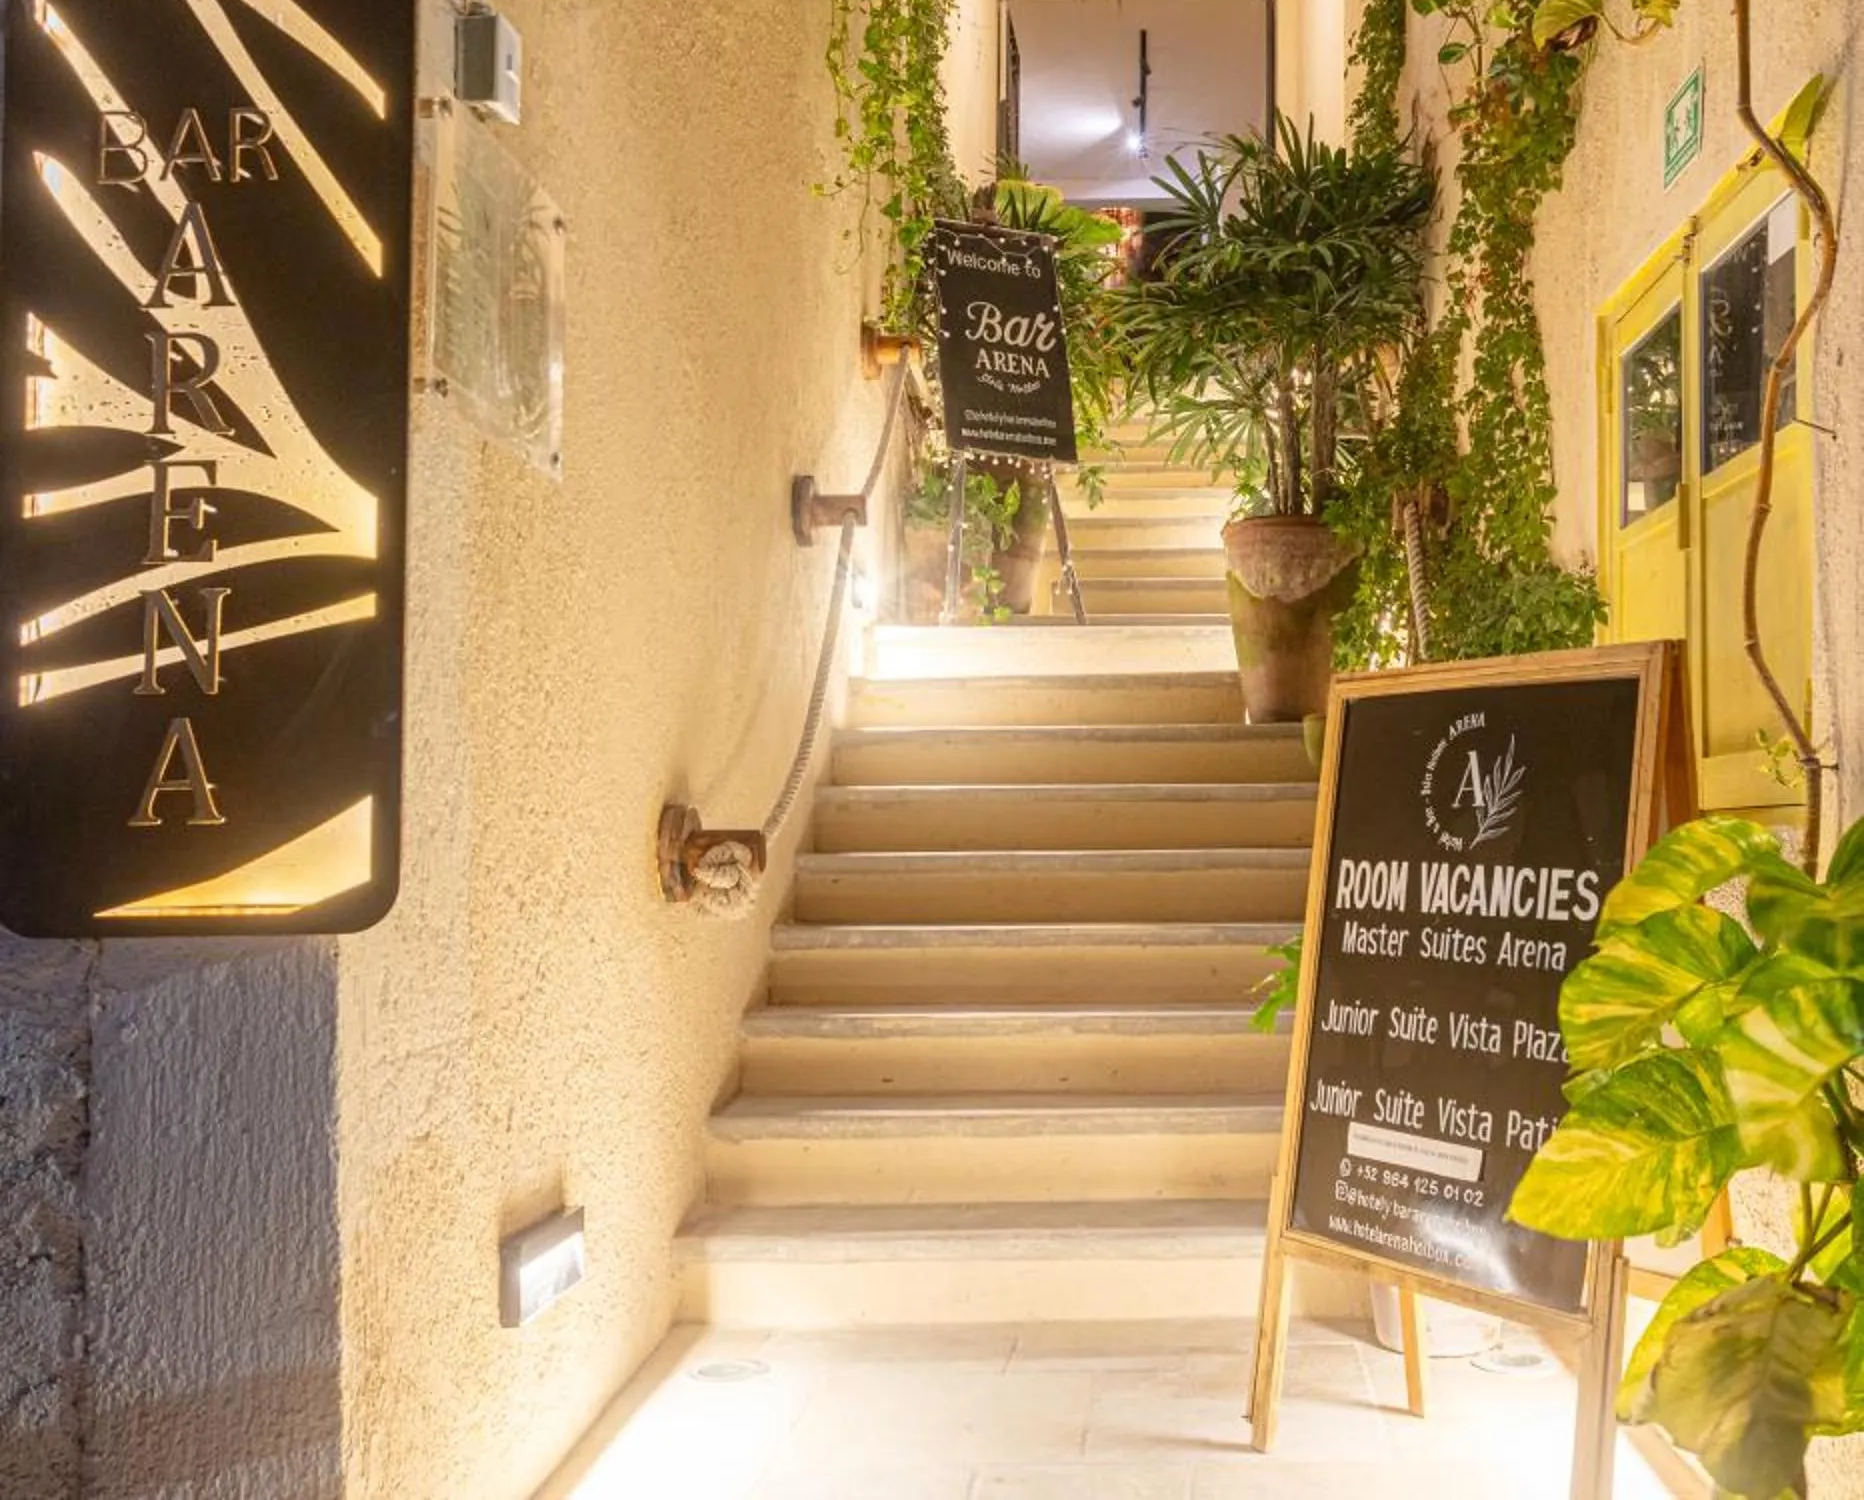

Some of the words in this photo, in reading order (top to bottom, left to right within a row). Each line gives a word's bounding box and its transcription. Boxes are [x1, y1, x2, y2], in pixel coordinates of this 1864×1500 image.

[98, 107, 279, 184] BAR
[947, 250, 1021, 276] Welcome
[1023, 261, 1041, 278] to
[965, 301, 1057, 352] Bar
[975, 347, 1050, 379] ARENA
[127, 202, 237, 827] ARENA
[1448, 711, 1486, 741] ARENA
[1451, 749, 1487, 808] A
[1336, 859, 1408, 912] ROOM
[1420, 861, 1599, 921] VACANCIES
[1342, 920, 1409, 957] Master
[1420, 927, 1487, 964] Suites
[1497, 931, 1566, 971] Arena
[1321, 999, 1379, 1037] Junior
[1388, 1006, 1438, 1044] Suite
[1449, 1011, 1501, 1053] Vista
[1310, 1078, 1362, 1118] Junior
[1373, 1088, 1425, 1129] Suite
[1438, 1097, 1493, 1143] Vista
[1357, 1165, 1378, 1181] +52
[1413, 1176, 1439, 1196] 125
[1443, 1183, 1459, 1201] 01
[1463, 1188, 1484, 1207] 02
